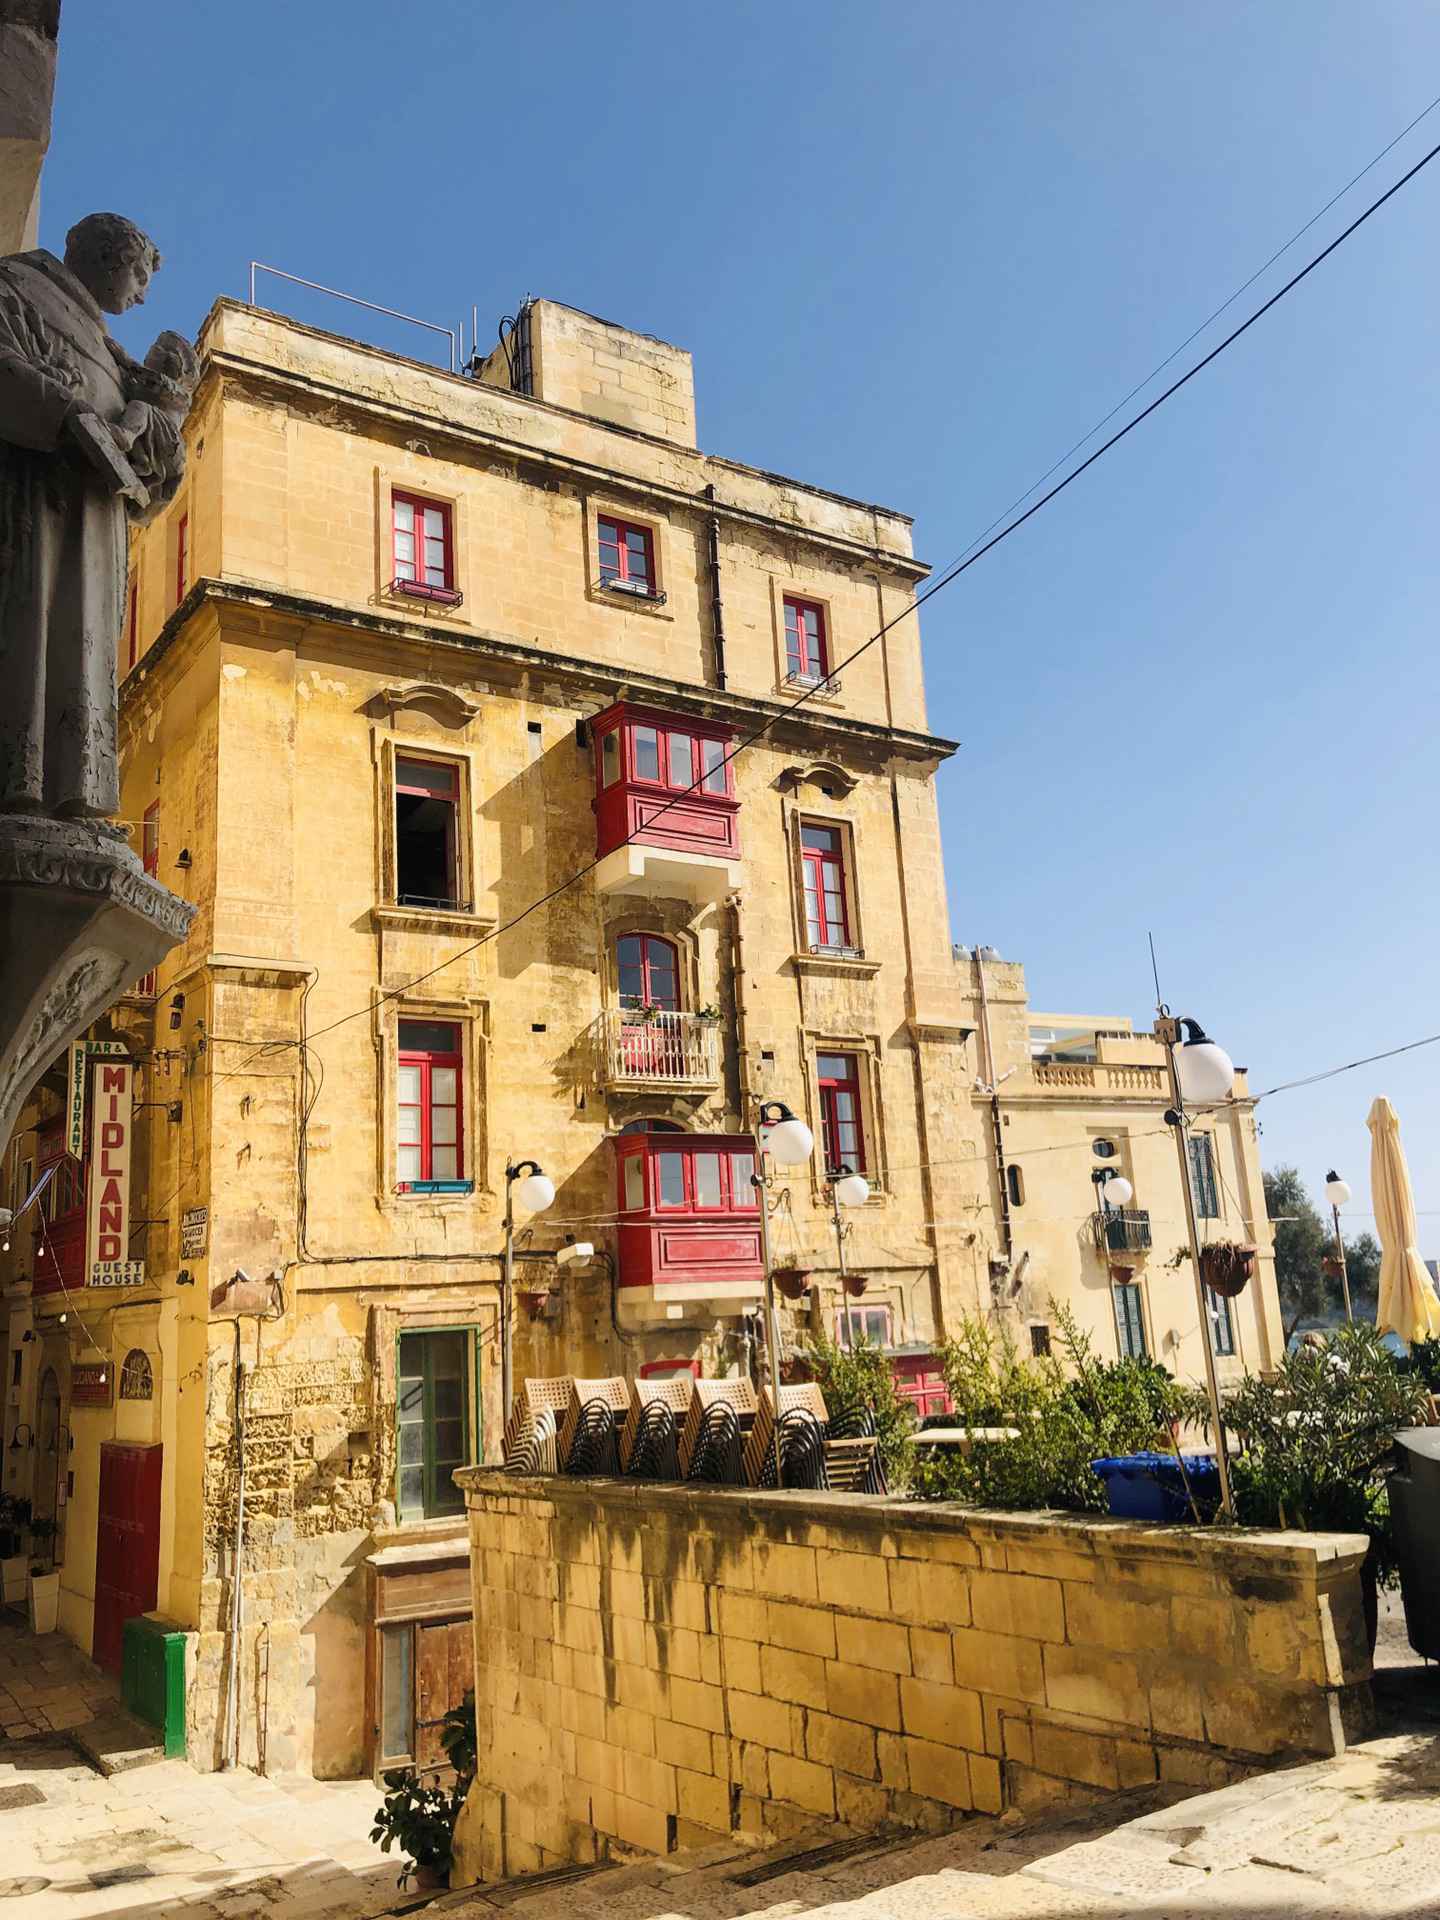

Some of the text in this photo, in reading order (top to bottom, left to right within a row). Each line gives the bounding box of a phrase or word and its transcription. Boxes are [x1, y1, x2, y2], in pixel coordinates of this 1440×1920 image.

[86, 1041, 122, 1055] BAR &
[72, 1049, 83, 1155] RESTAURANT
[98, 1066, 125, 1262] MIDLAND
[93, 1262, 142, 1273] GUEST
[93, 1274, 142, 1285] HOUSE
